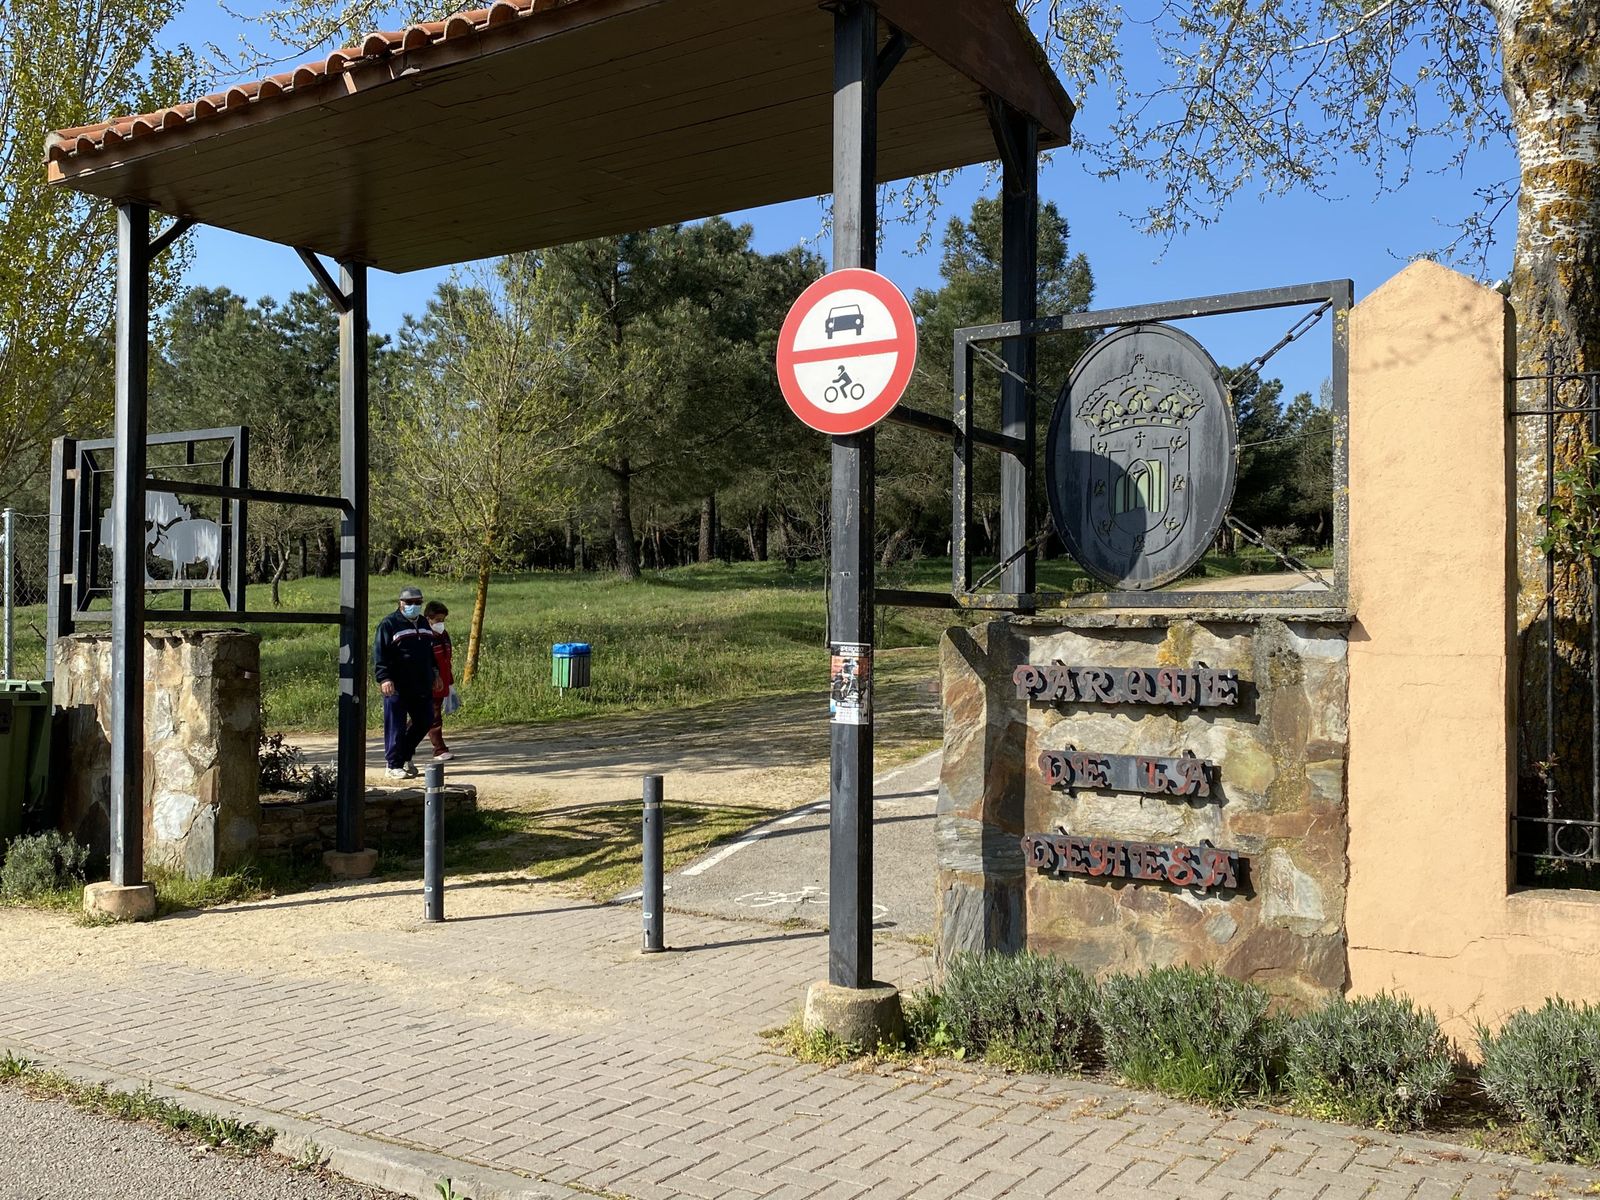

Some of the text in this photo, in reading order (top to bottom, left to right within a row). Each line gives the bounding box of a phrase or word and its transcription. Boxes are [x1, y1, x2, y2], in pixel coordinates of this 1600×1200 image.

[1013, 665, 1236, 705] PARQUE
[1038, 752, 1210, 797] DE LA
[1021, 835, 1237, 888] DEHESA
